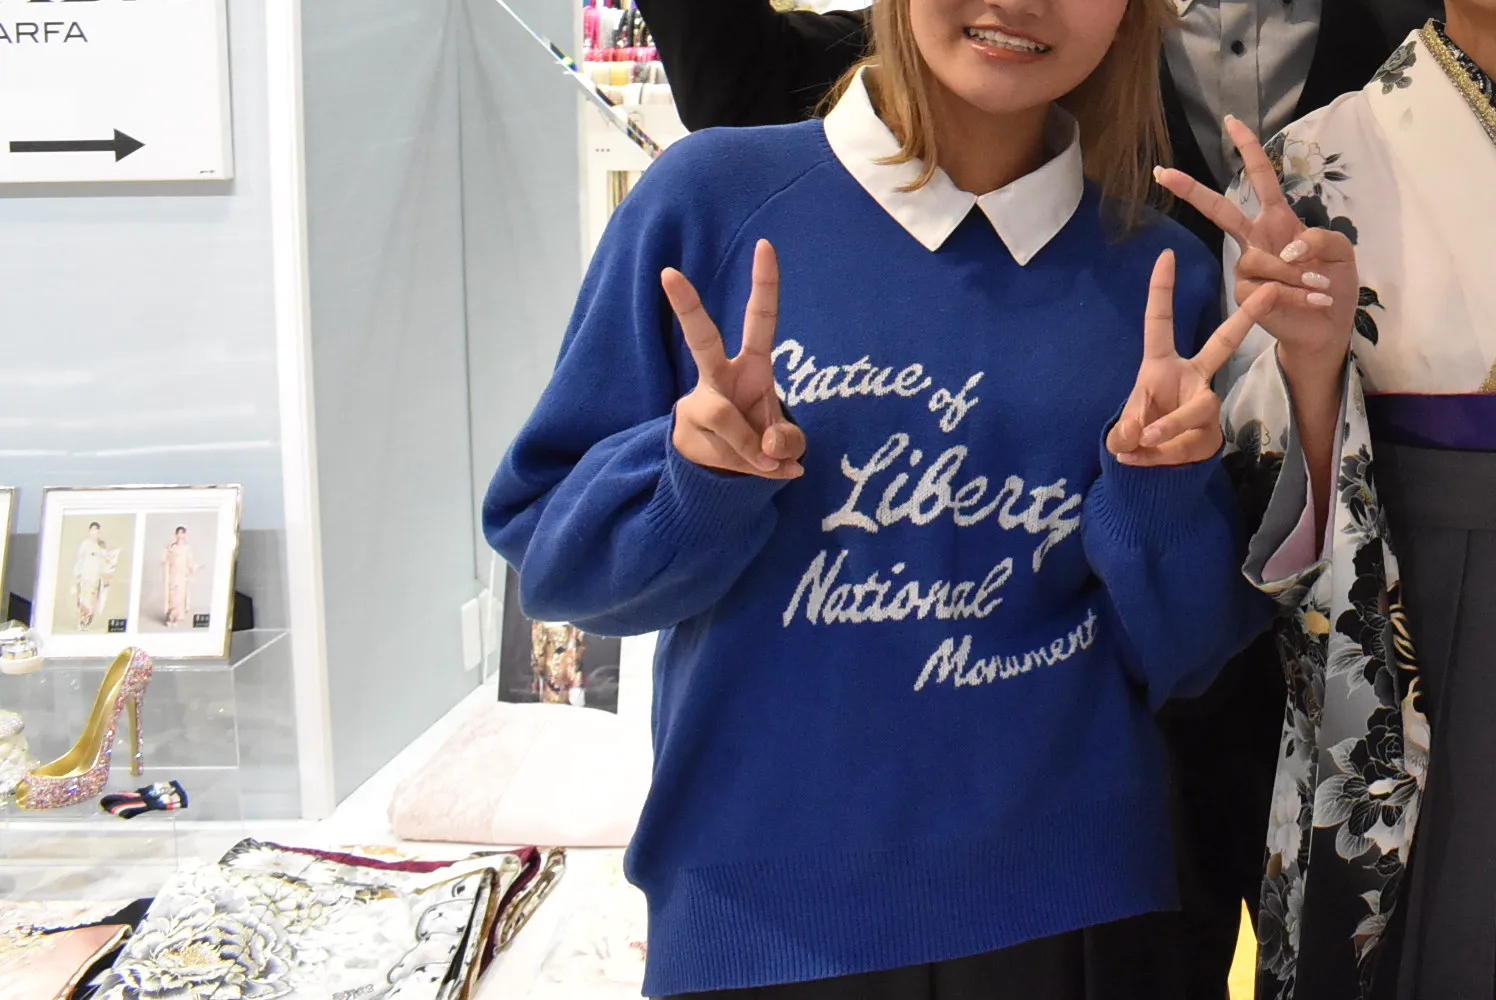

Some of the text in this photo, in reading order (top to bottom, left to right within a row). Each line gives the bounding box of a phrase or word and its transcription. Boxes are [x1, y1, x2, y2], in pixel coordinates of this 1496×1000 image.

[771, 339, 985, 433] Statue of
[821, 432, 1083, 573] Liberty
[783, 549, 1013, 628] National
[914, 607, 1097, 692] Monument
